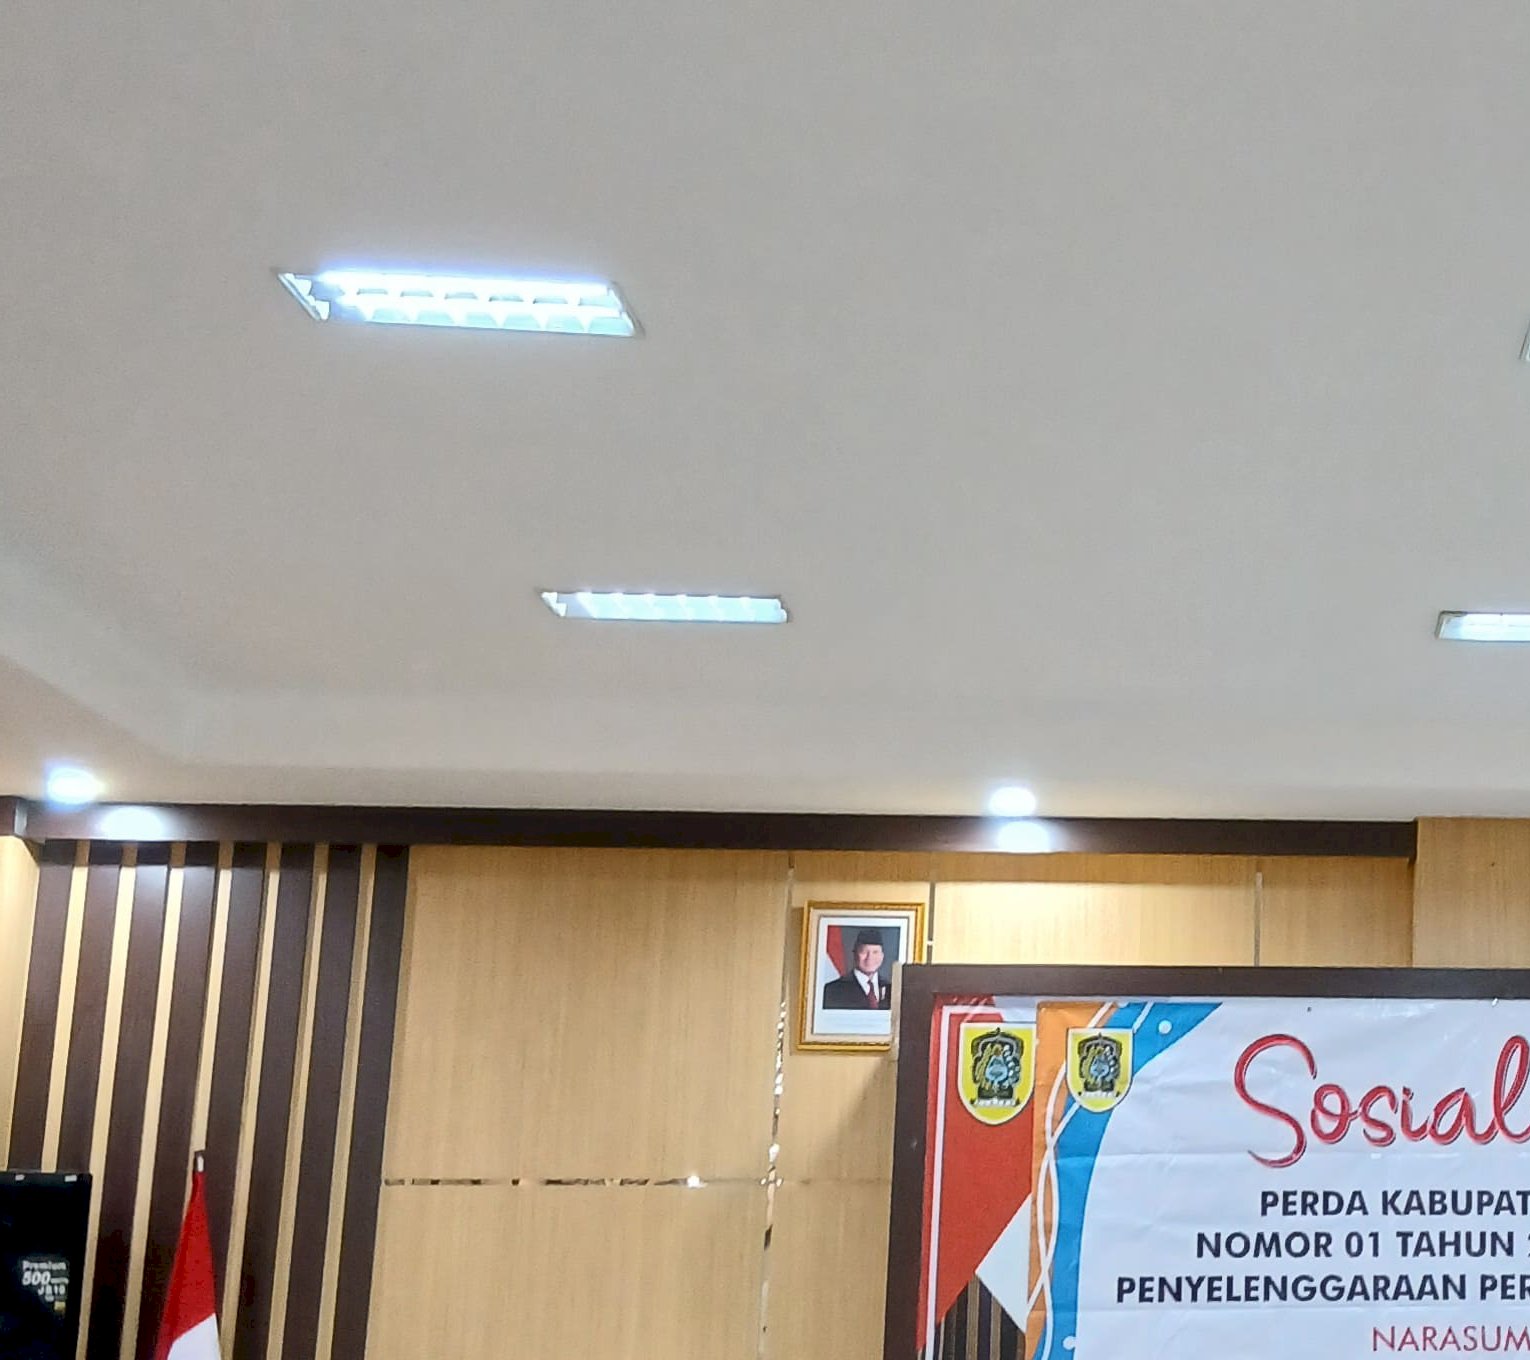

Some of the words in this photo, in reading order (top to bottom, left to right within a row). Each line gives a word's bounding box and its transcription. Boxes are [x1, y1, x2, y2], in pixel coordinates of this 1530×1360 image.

[1260, 1189, 1370, 1218] PERDA
[1196, 1230, 1333, 1259] NOMOR
[1344, 1230, 1380, 1259] 01
[1395, 1230, 1515, 1258] TAHUN
[1116, 1273, 1467, 1304] PENYELENGGARAAN
